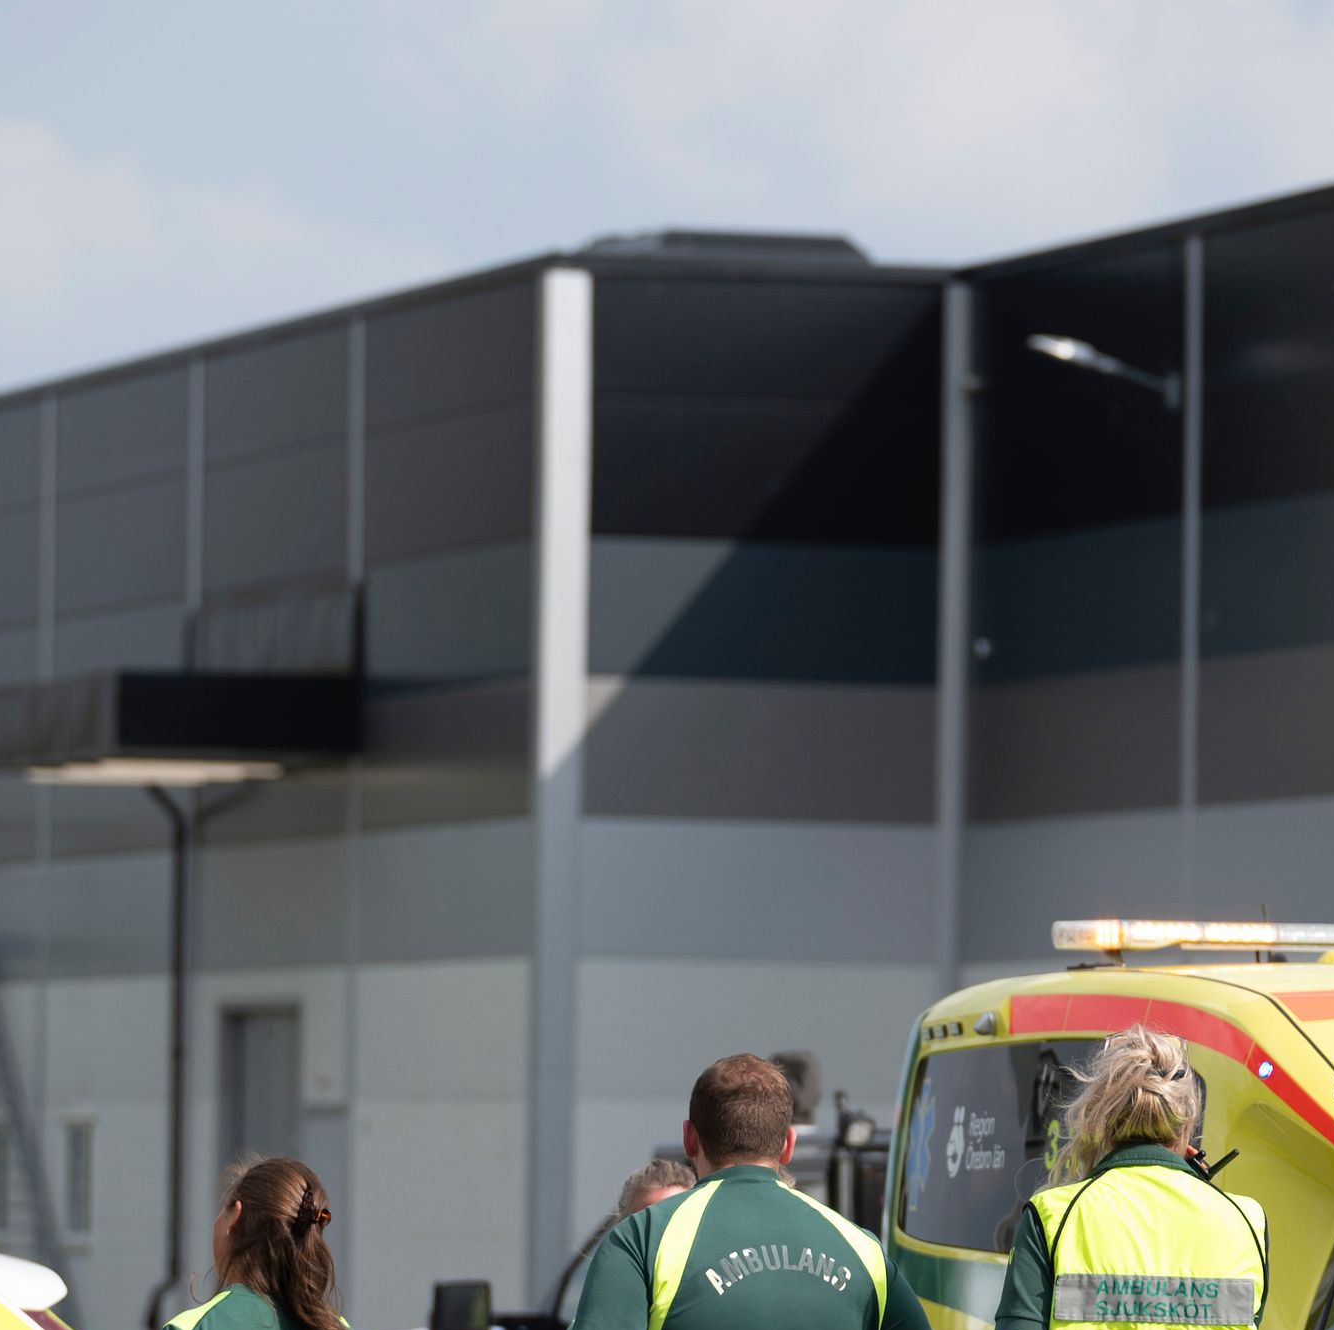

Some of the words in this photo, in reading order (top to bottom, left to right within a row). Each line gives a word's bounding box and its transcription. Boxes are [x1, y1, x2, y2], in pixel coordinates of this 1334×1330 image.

[969, 1111, 996, 1142] Region
[965, 1140, 992, 1171] Örebro
[993, 1143, 1006, 1169] län
[705, 1244, 852, 1296] AMBULANS
[1095, 1279, 1220, 1299] AMBULANS
[1094, 1299, 1216, 1320] SJUKSKÖT.
